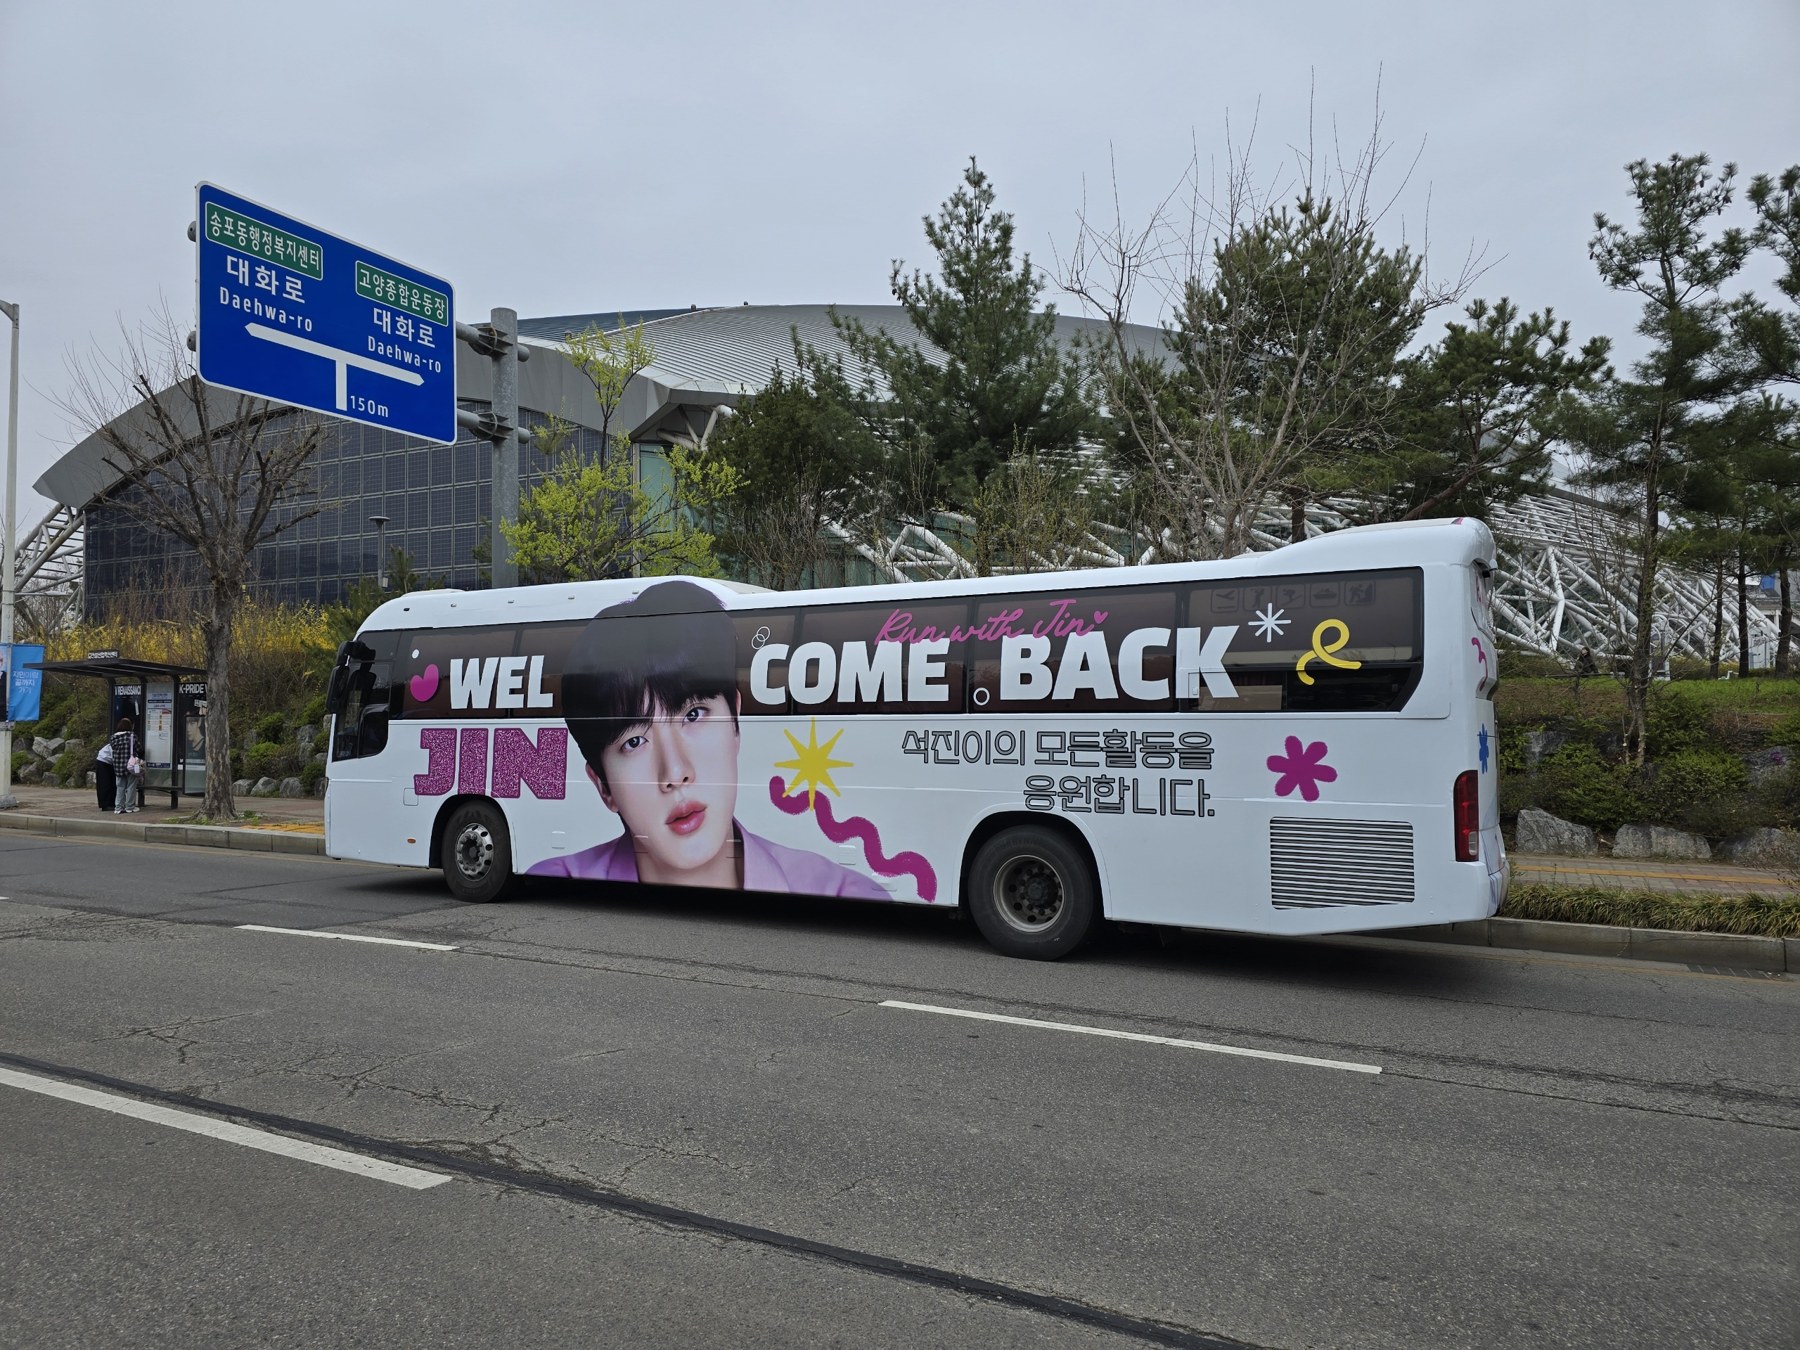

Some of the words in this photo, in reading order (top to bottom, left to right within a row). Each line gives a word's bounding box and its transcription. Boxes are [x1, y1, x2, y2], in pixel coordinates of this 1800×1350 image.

[209, 211, 320, 271] 송포동행정복지센터
[226, 255, 306, 304] 대화로
[359, 268, 445, 320] 고양종합운동장
[219, 286, 313, 332] Daehwa-ro
[373, 307, 436, 349] 대화로
[367, 335, 442, 373] Daehwa-ro
[350, 395, 389, 418] 150m
[874, 608, 946, 646] Run
[949, 608, 1025, 643] with
[1032, 598, 1095, 639] Jin
[179, 684, 204, 694] K-PRIDE
[449, 654, 554, 709] WEL
[750, 635, 951, 706] COME
[1000, 625, 1240, 701] BACK
[413, 727, 569, 800] JIN
[902, 730, 1026, 766] 석진이의
[1023, 774, 1216, 818] 응원합니다.
